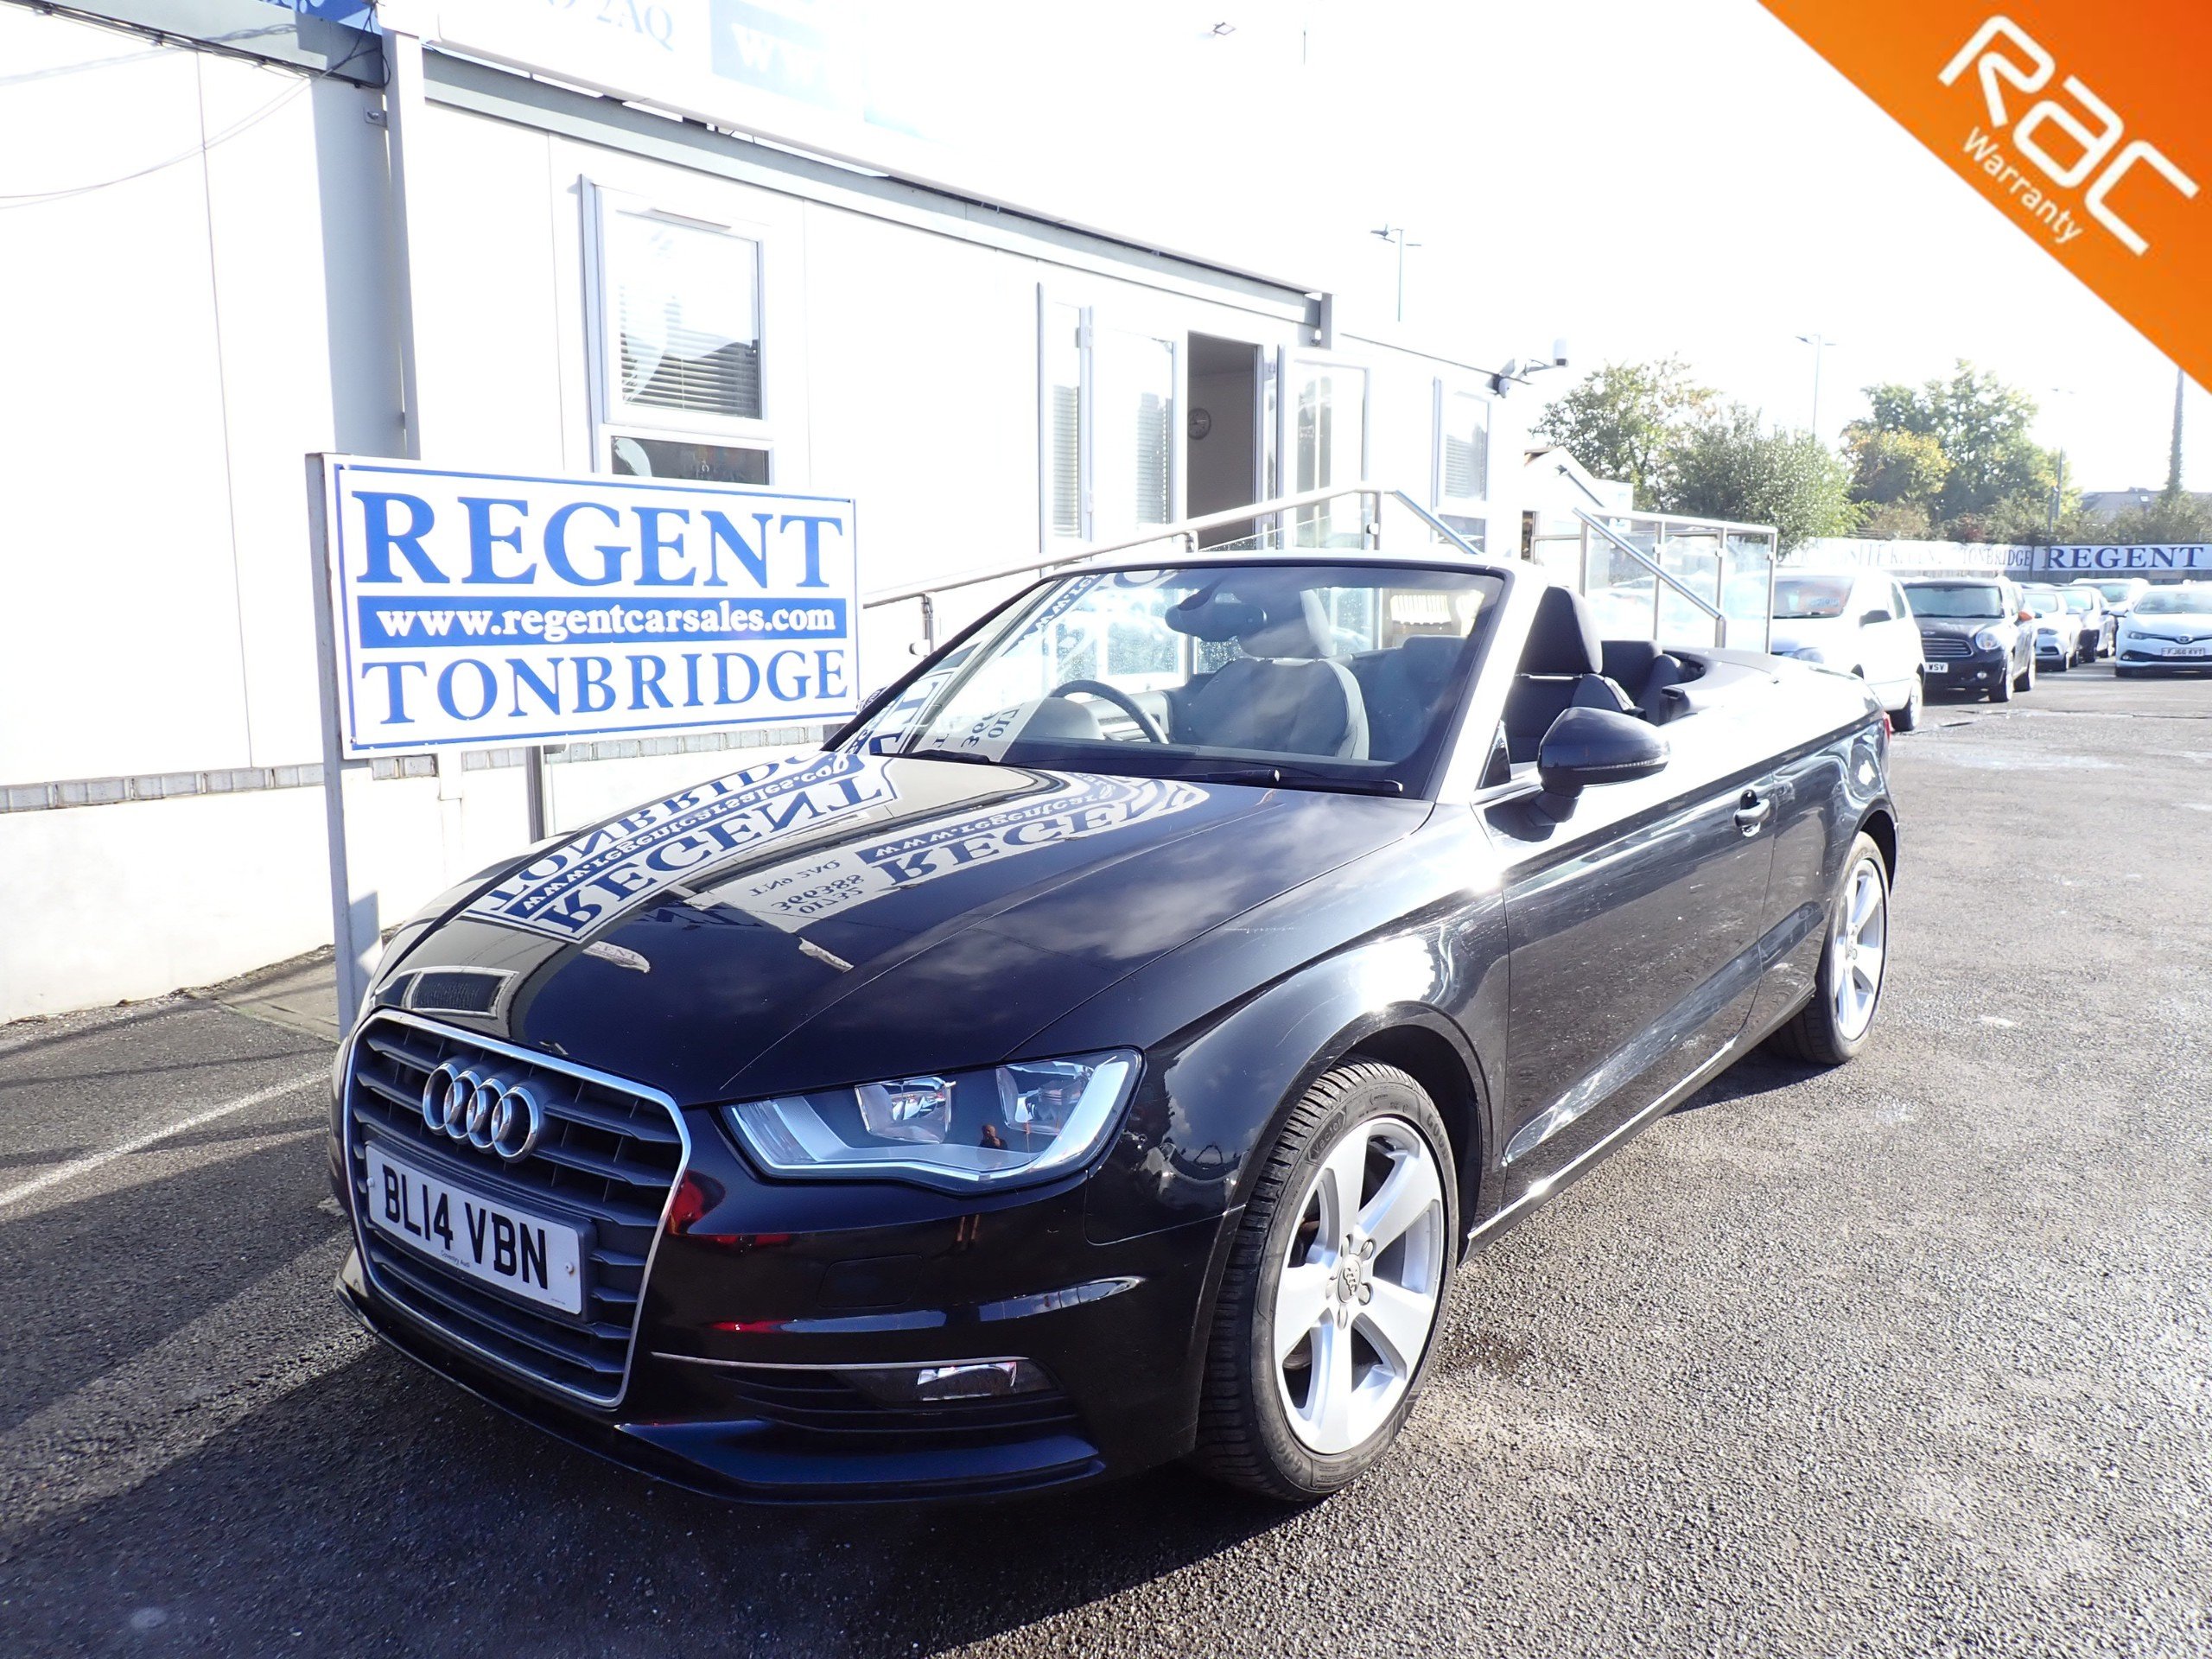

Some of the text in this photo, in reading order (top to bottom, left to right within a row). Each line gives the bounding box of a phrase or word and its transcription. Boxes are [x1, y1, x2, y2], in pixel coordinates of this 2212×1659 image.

[352, 490, 843, 588] REGENT
[2042, 546, 2204, 570] REGENT
[376, 600, 836, 643] www.regentcarsales.com
[361, 648, 849, 725] TONBRIDGE
[1928, 663, 1945, 671] WSV
[382, 1163, 549, 1291] BL14 VBN
